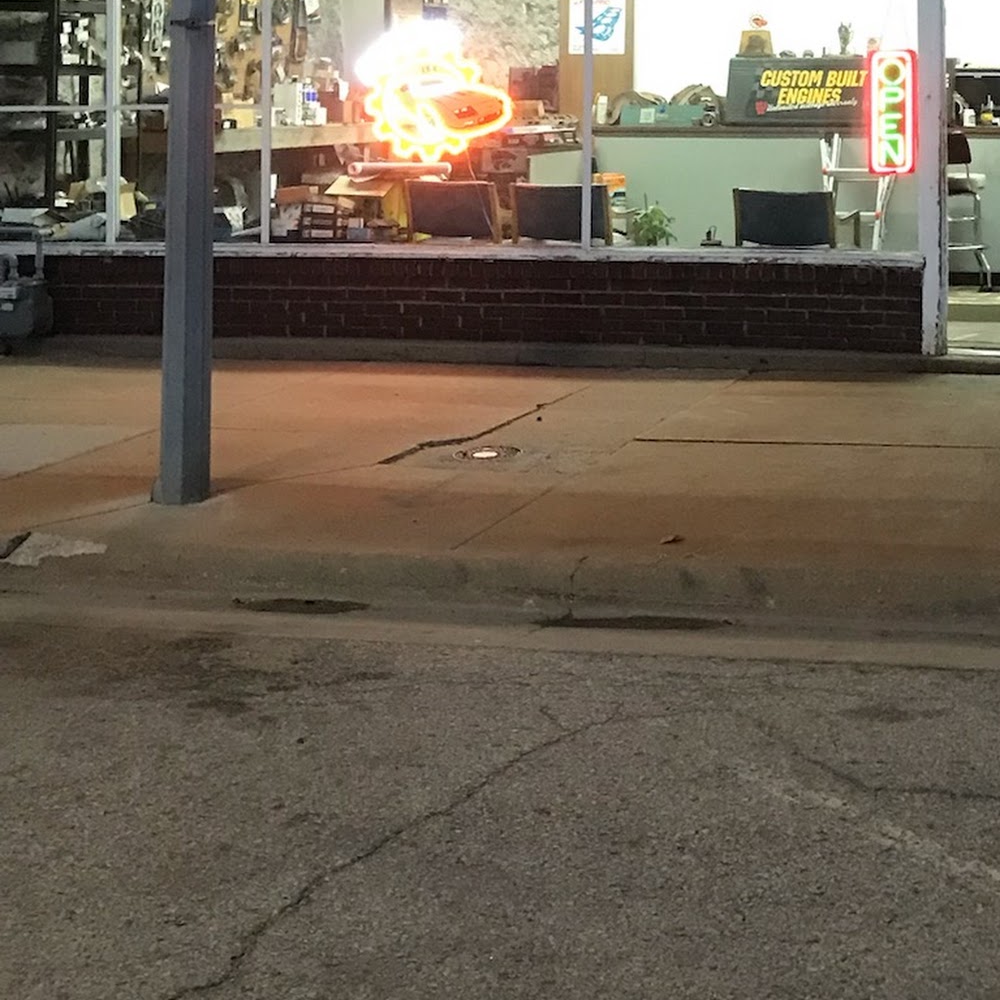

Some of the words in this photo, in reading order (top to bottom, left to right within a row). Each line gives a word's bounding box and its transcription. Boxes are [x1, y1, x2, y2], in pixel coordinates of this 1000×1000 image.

[760, 70, 824, 87] CUSTOM
[826, 70, 868, 87] BUILT
[777, 88, 843, 104] ENGINES
[878, 58, 906, 166] OPEN
